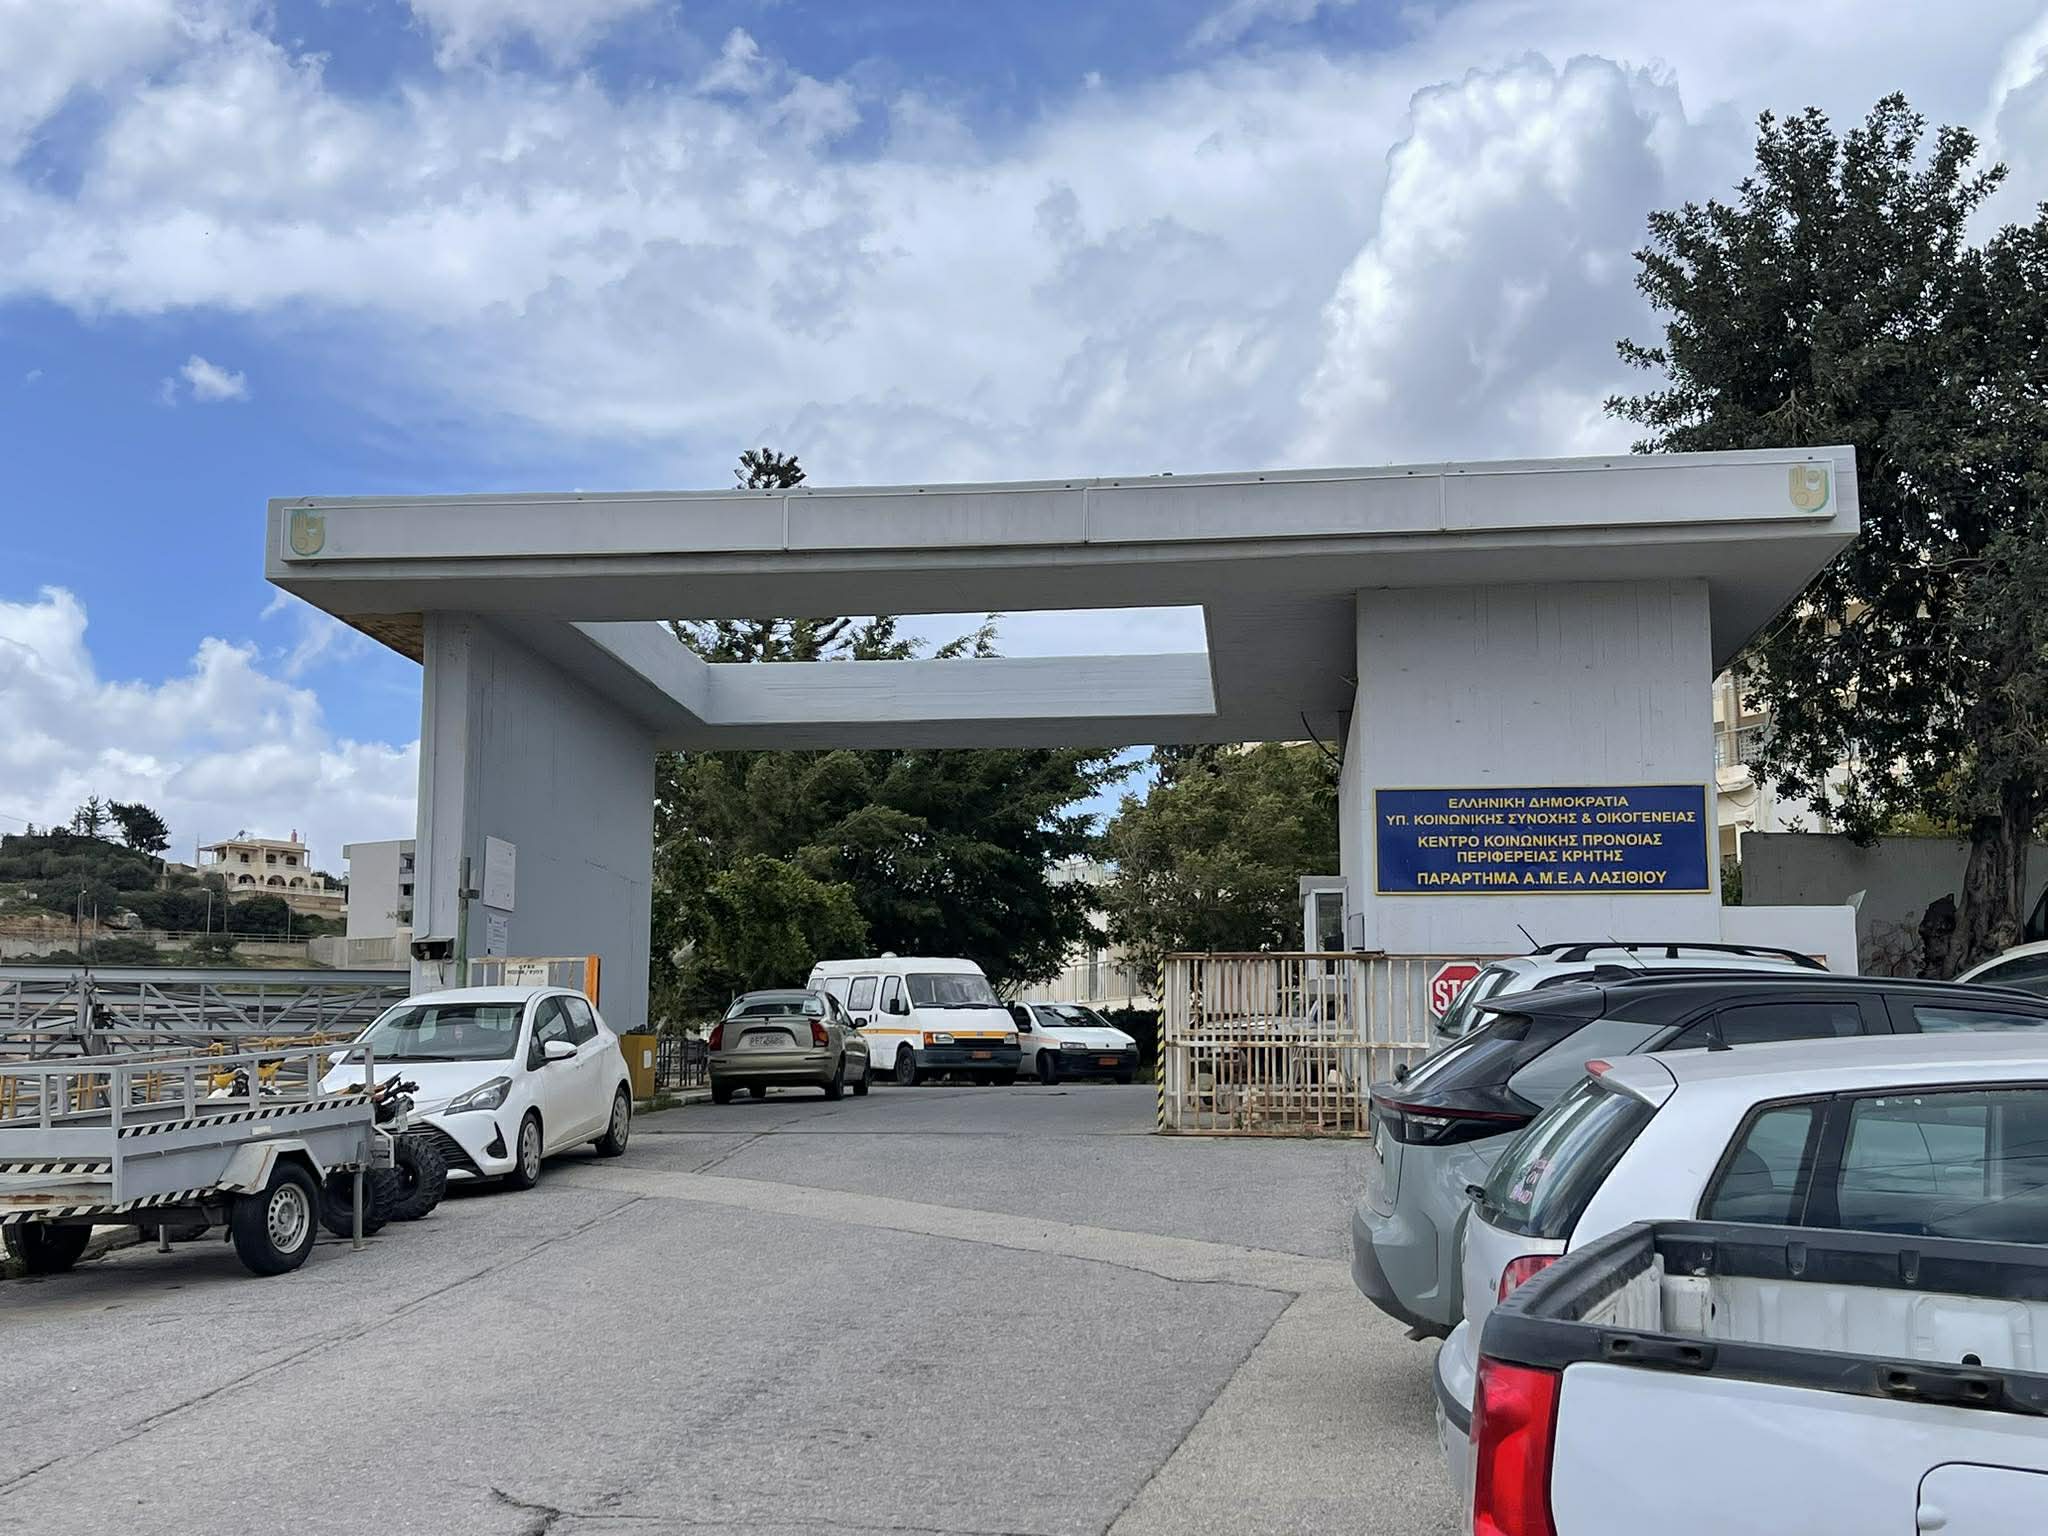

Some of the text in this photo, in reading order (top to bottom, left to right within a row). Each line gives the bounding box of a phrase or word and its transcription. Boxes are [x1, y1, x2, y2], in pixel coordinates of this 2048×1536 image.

[1448, 796, 1629, 809] ΕΛΛΗΝΙΚΗ ΔΗΜΟΚΡΑΤΙΑ
[1385, 811, 1696, 826] ΥΠ. ΚΟΙΝΩΝΙΚΗΣ ΣΥΝΟΧΗΣ & ΟΙΚΟΓΕΝΕΙΑΣ
[1418, 833, 1663, 848] ΚΕΝΤΡΟ ΚΟΙΝΩΝΙΚΗΣ ΠΡΟΝΟΙΑΣ
[1457, 849, 1624, 863] ΠΕΡΙΦΕΡΕΙΑΣ ΚΡΗΤΗΣ
[1417, 870, 1667, 885] ΠΑΡΑΡΤΗΜΑ Α.Μ.Ε.Α ΛΑΣΙΘΙΟΥ
